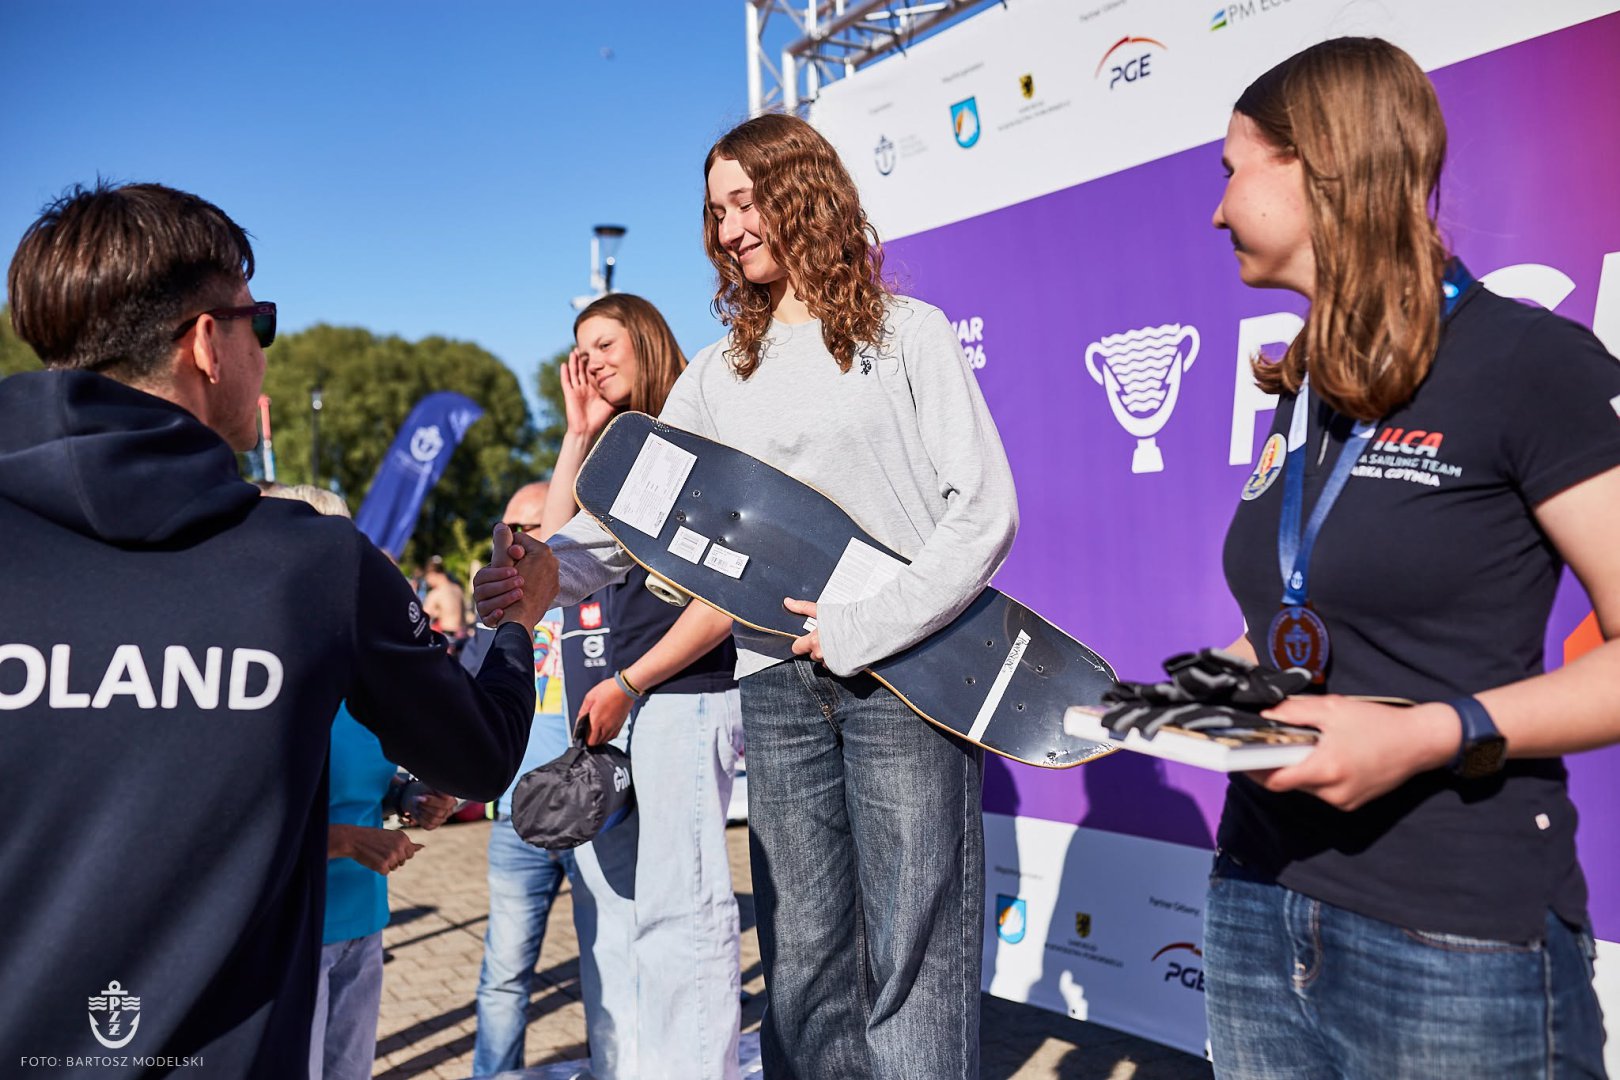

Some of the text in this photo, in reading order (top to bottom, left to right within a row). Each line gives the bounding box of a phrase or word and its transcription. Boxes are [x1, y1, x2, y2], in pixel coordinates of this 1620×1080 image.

[1228, 0, 1256, 23] PM
[1110, 53, 1152, 90] PGE
[1372, 427, 1443, 458] ILCA
[1421, 458, 1462, 478] TEAM
[0, 643, 284, 711] OLAND
